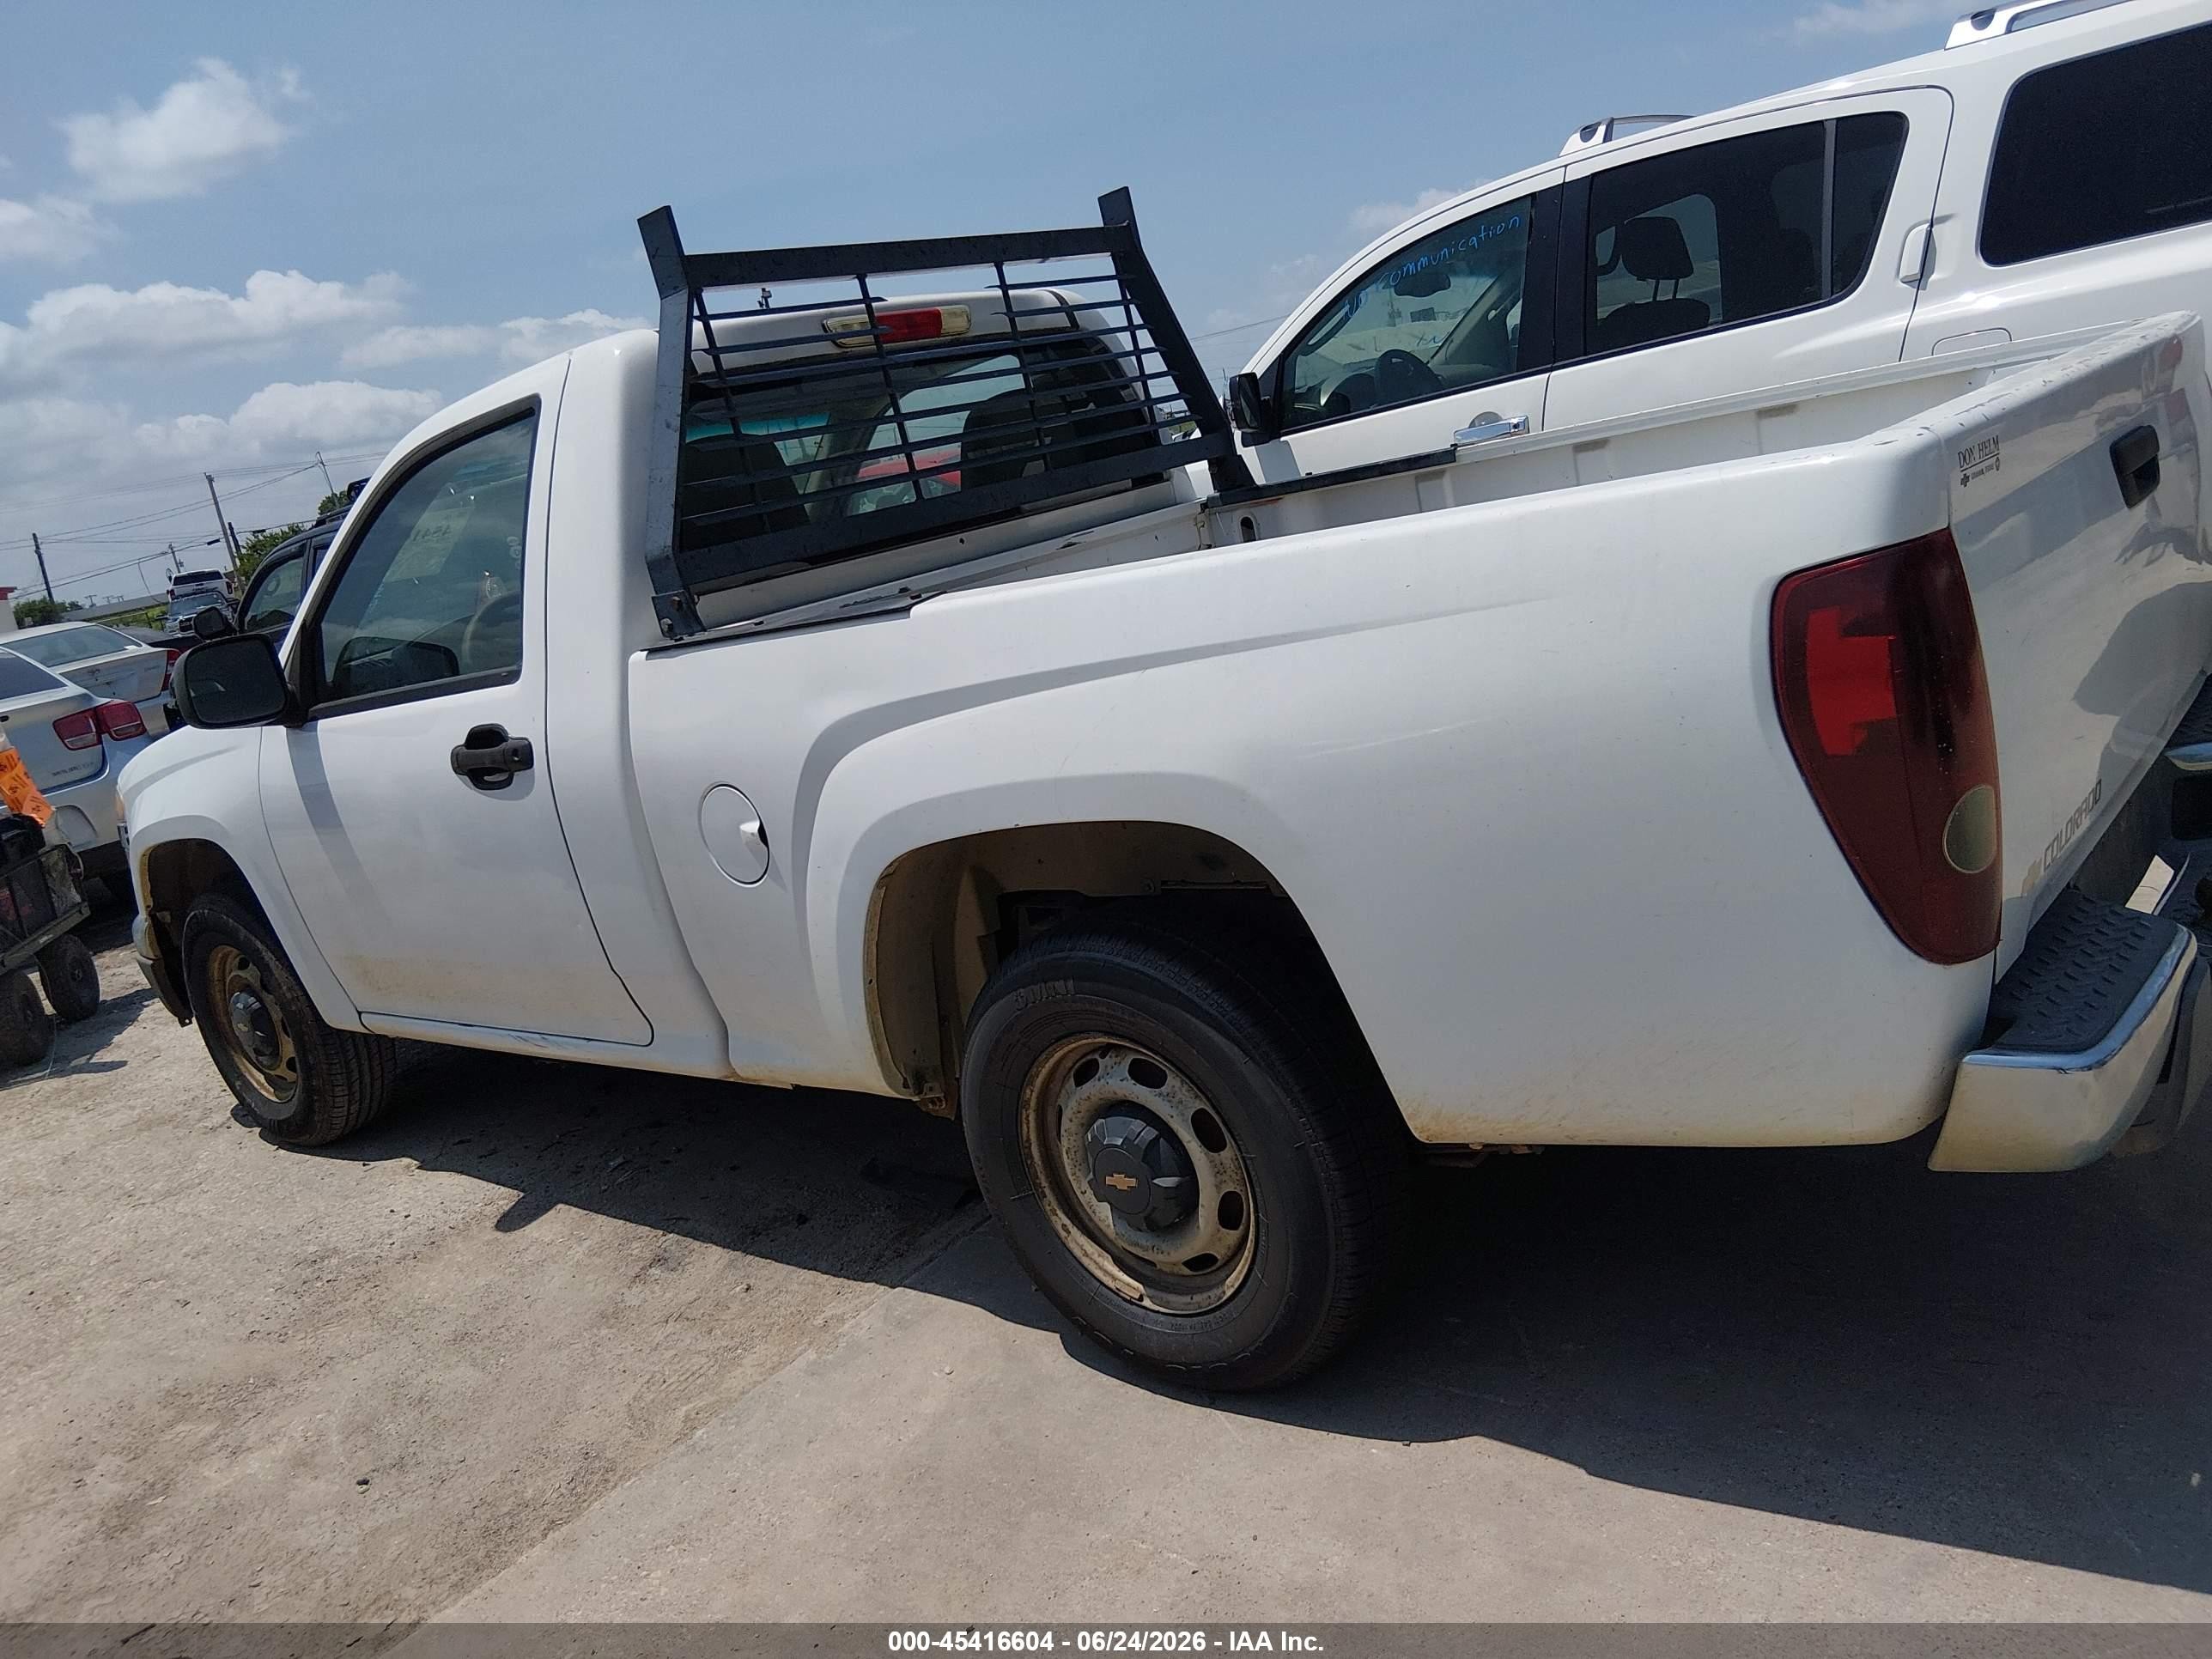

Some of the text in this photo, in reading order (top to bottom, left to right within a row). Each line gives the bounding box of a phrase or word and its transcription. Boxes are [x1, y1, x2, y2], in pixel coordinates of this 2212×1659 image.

[1958, 434, 2000, 469] DON HELM
[2044, 778, 2102, 872] COLORADO
